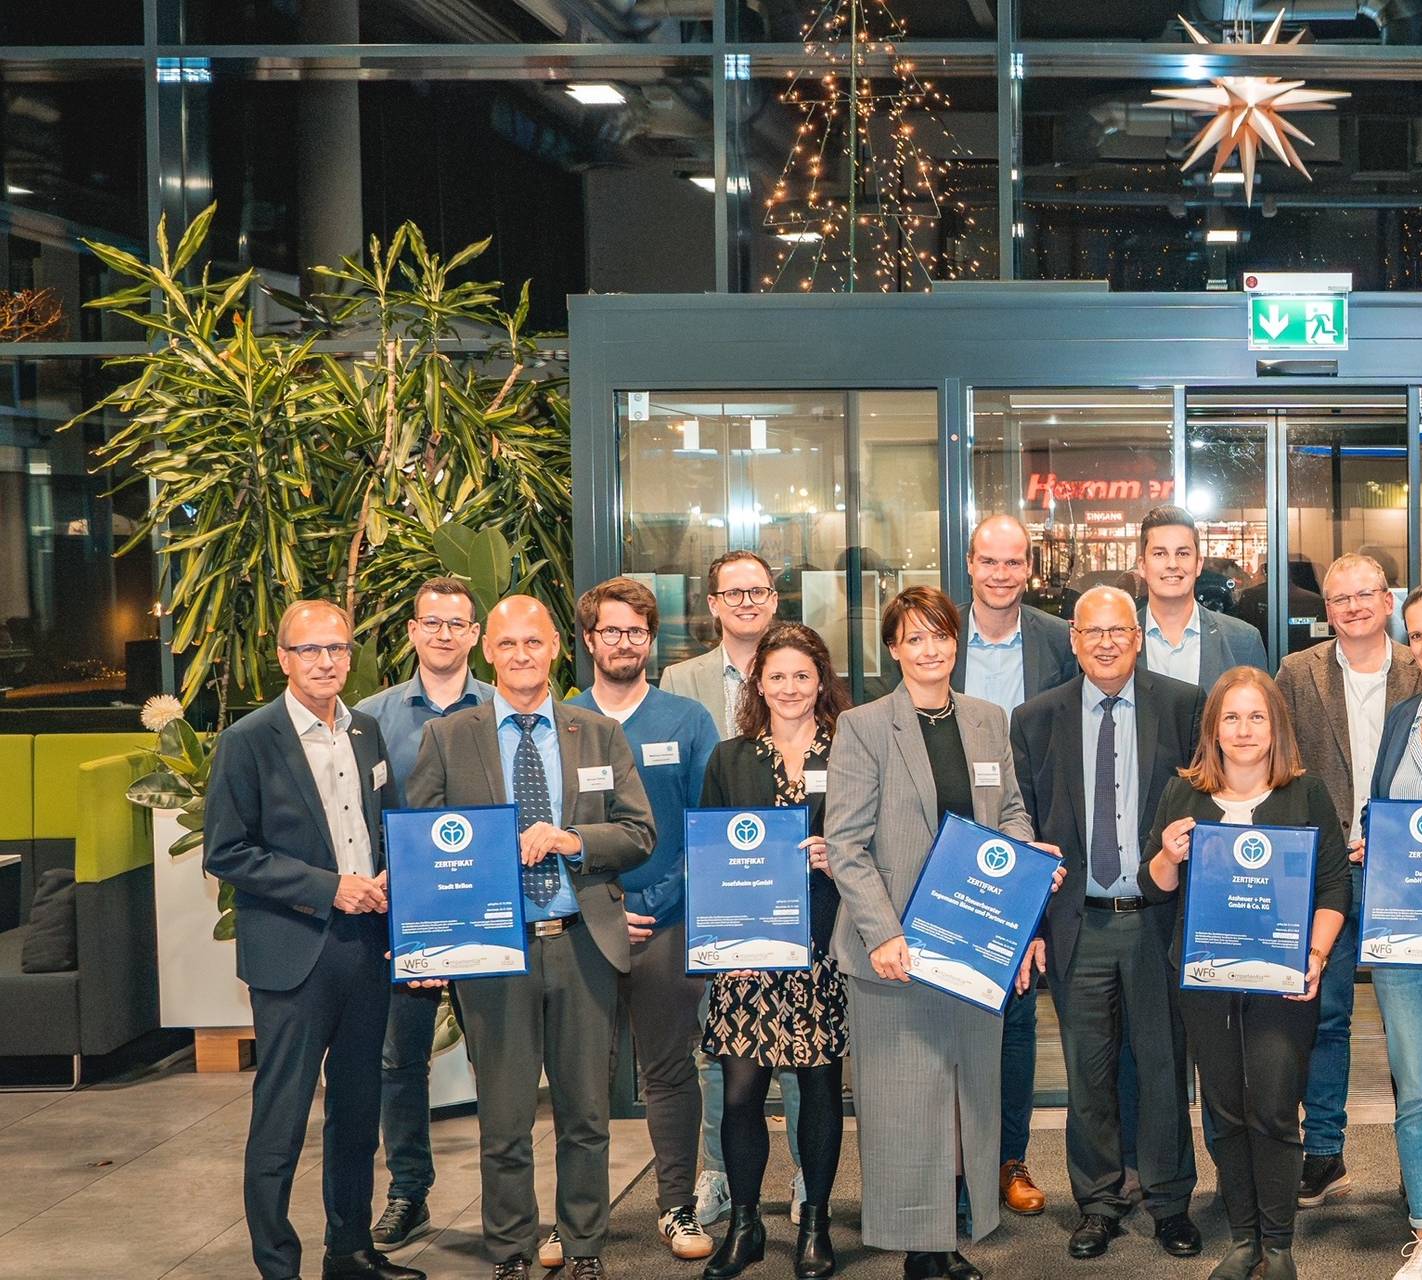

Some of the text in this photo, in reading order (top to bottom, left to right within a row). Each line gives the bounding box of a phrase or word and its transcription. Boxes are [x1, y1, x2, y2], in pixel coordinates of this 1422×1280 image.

[434, 859, 474, 868] ZERTIFIKAT
[729, 857, 765, 865] ZERTIFIKAT
[967, 876, 1003, 895] ZERTIFIKAT
[1232, 876, 1269, 885] ZERTIFIKAT
[1228, 902, 1246, 910] GmbH
[1370, 944, 1392, 954] WFG
[698, 951, 720, 961] WFG
[404, 958, 428, 969] WFG
[1193, 967, 1216, 978] WFG
